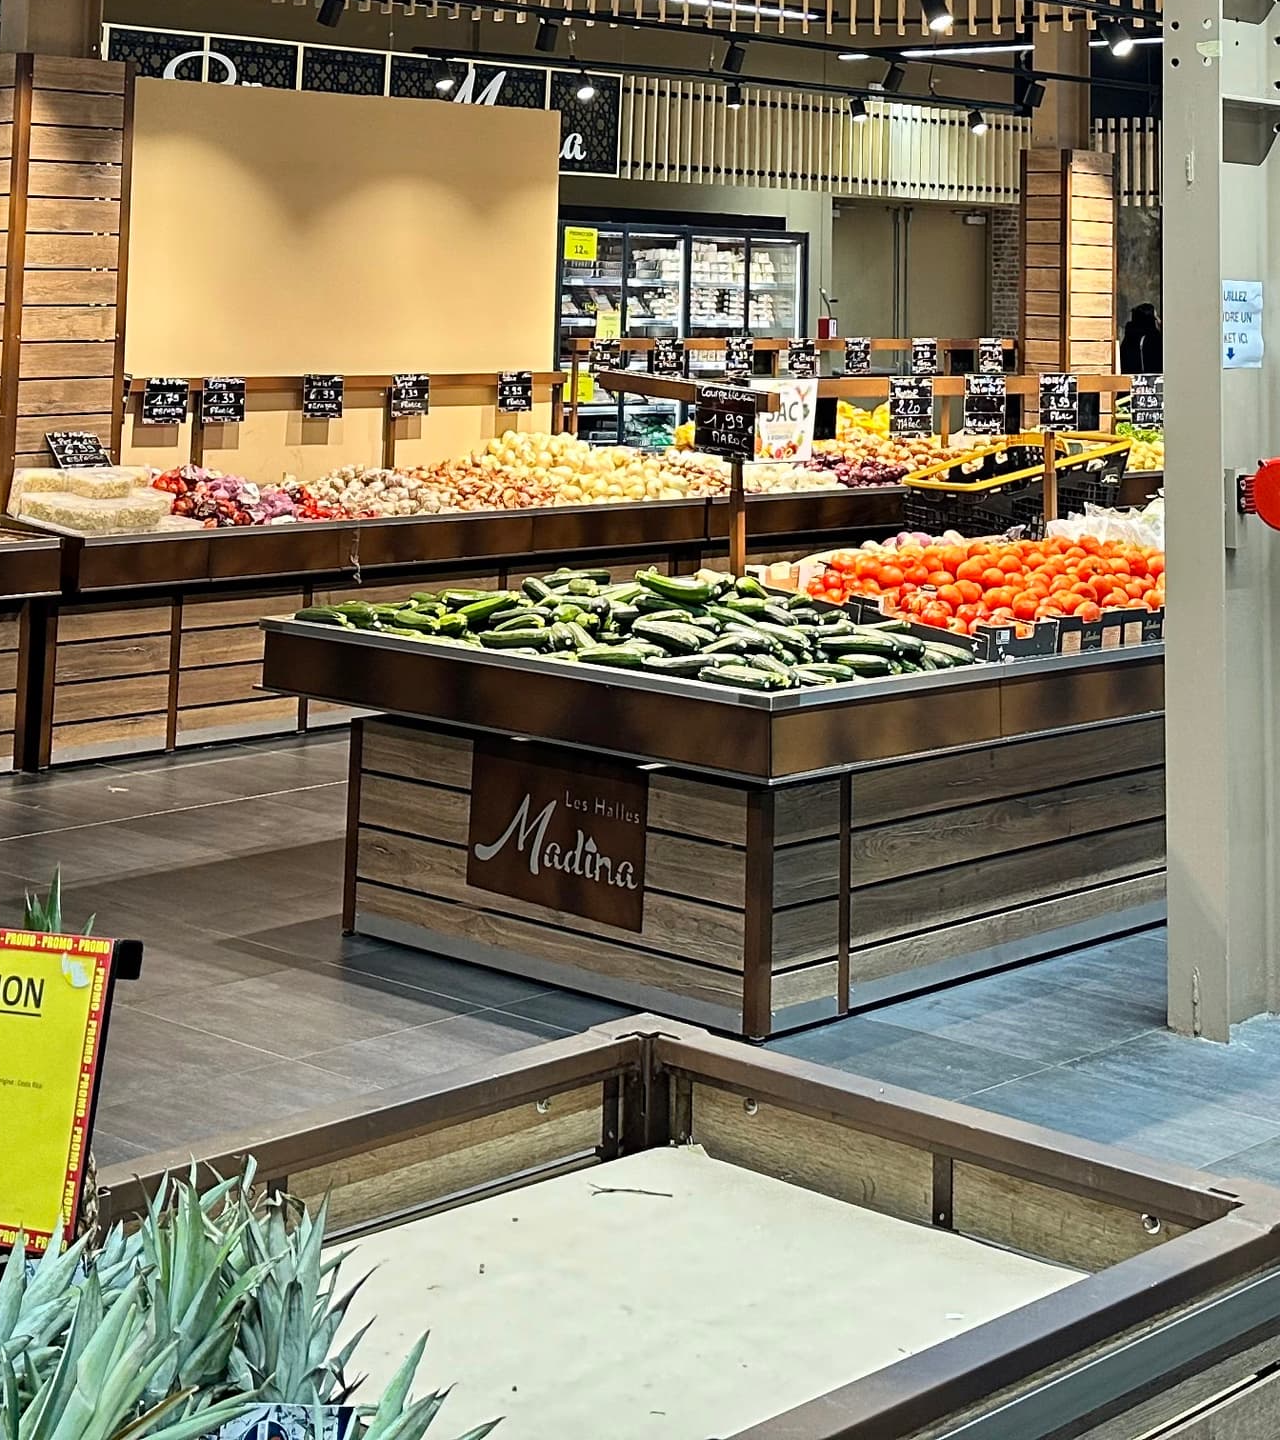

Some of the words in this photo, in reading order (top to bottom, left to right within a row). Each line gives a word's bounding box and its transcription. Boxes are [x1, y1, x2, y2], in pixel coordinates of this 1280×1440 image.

[1223, 311, 1239, 323] DRE
[1240, 311, 1253, 324] UN
[564, 790, 588, 812] Les
[594, 796, 641, 824] Halles
[474, 792, 639, 890] Madina
[5, 932, 36, 948] PROMO
[41, 935, 73, 951] PROMO
[78, 939, 110, 955] PROMO
[90, 967, 105, 1011] PROMO
[83, 1019, 98, 1065] PROMO
[76, 1073, 91, 1118] PROMO
[68, 1126, 83, 1172] PROMO
